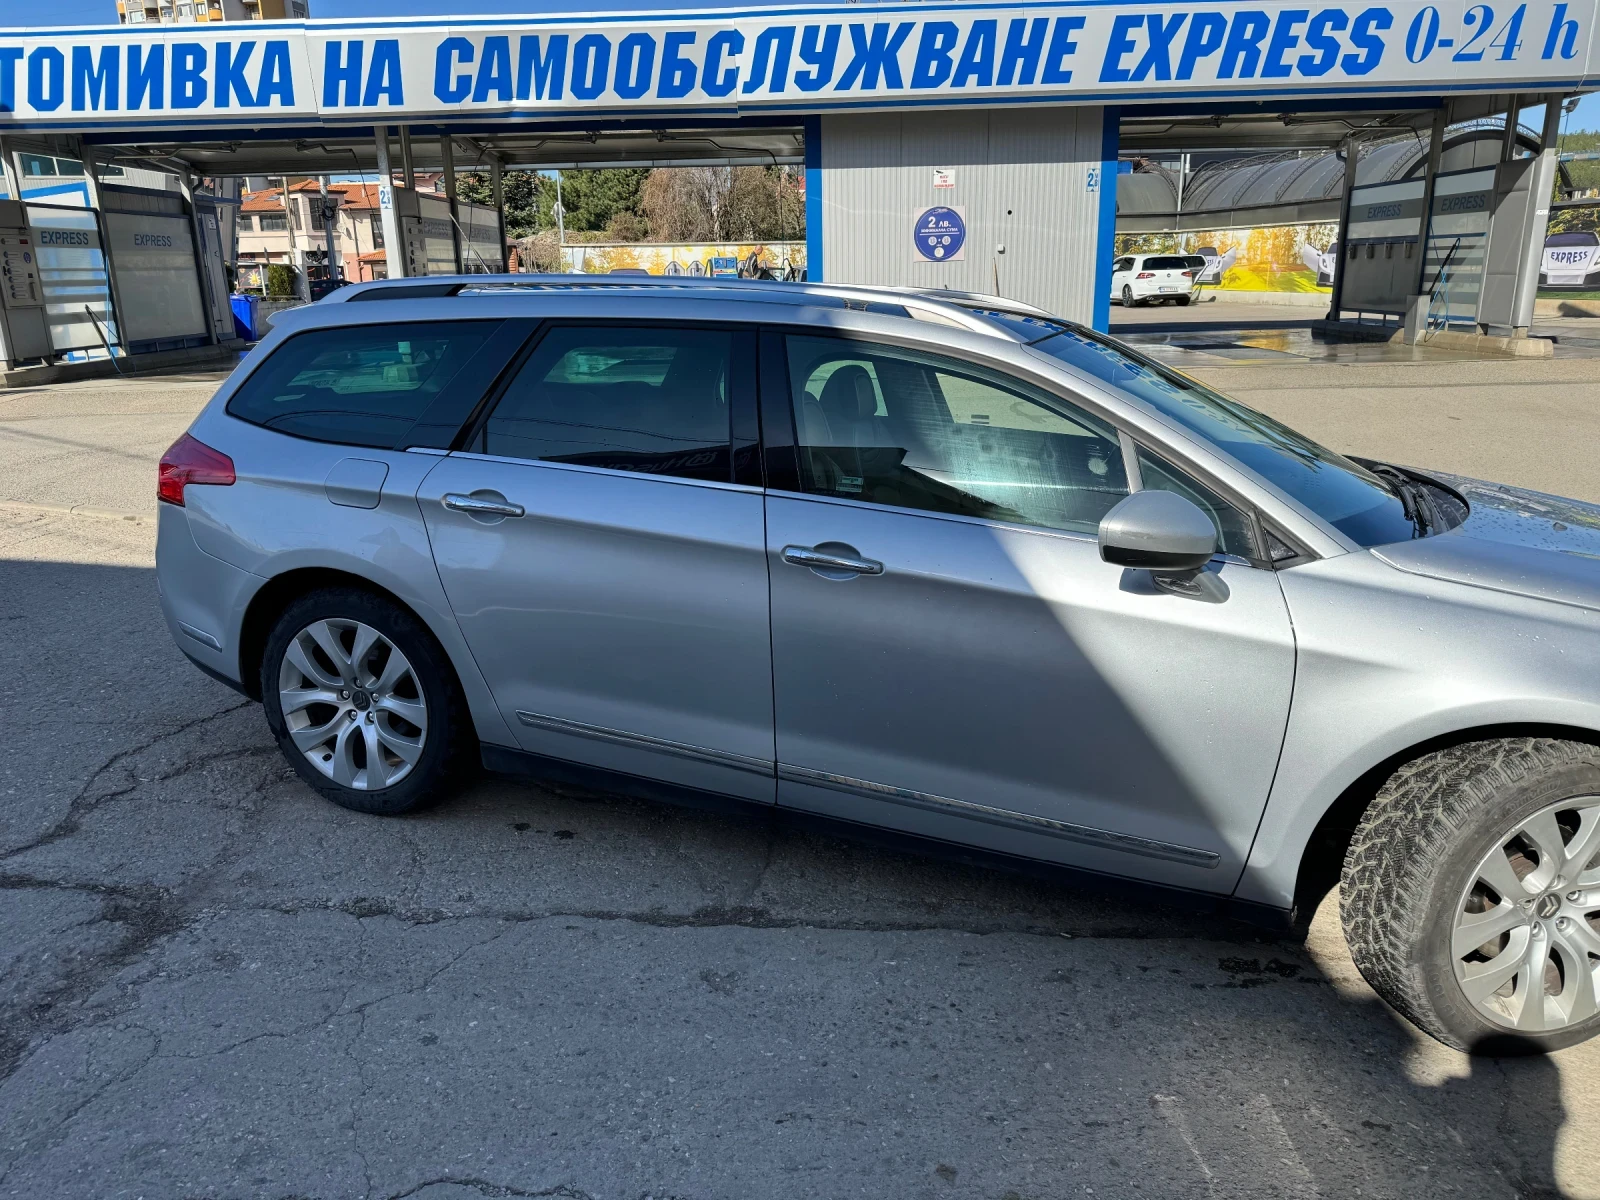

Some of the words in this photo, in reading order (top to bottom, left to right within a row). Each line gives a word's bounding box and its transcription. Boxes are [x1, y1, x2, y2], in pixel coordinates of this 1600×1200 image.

[322, 39, 405, 108] НА
[433, 15, 1087, 105] САМООБСЛУЖВАНЕ
[1099, 7, 1394, 83] EXPRESS
[1405, 4, 1527, 64] 0-24
[1541, 3, 1579, 60] h
[1367, 203, 1402, 219] EXPRESS
[1440, 195, 1486, 212] EXPRESS
[928, 216, 936, 228] 2
[41, 231, 89, 246] EXPRESS
[134, 233, 172, 247] EXPRESS
[1550, 250, 1588, 265] EXPRESS
